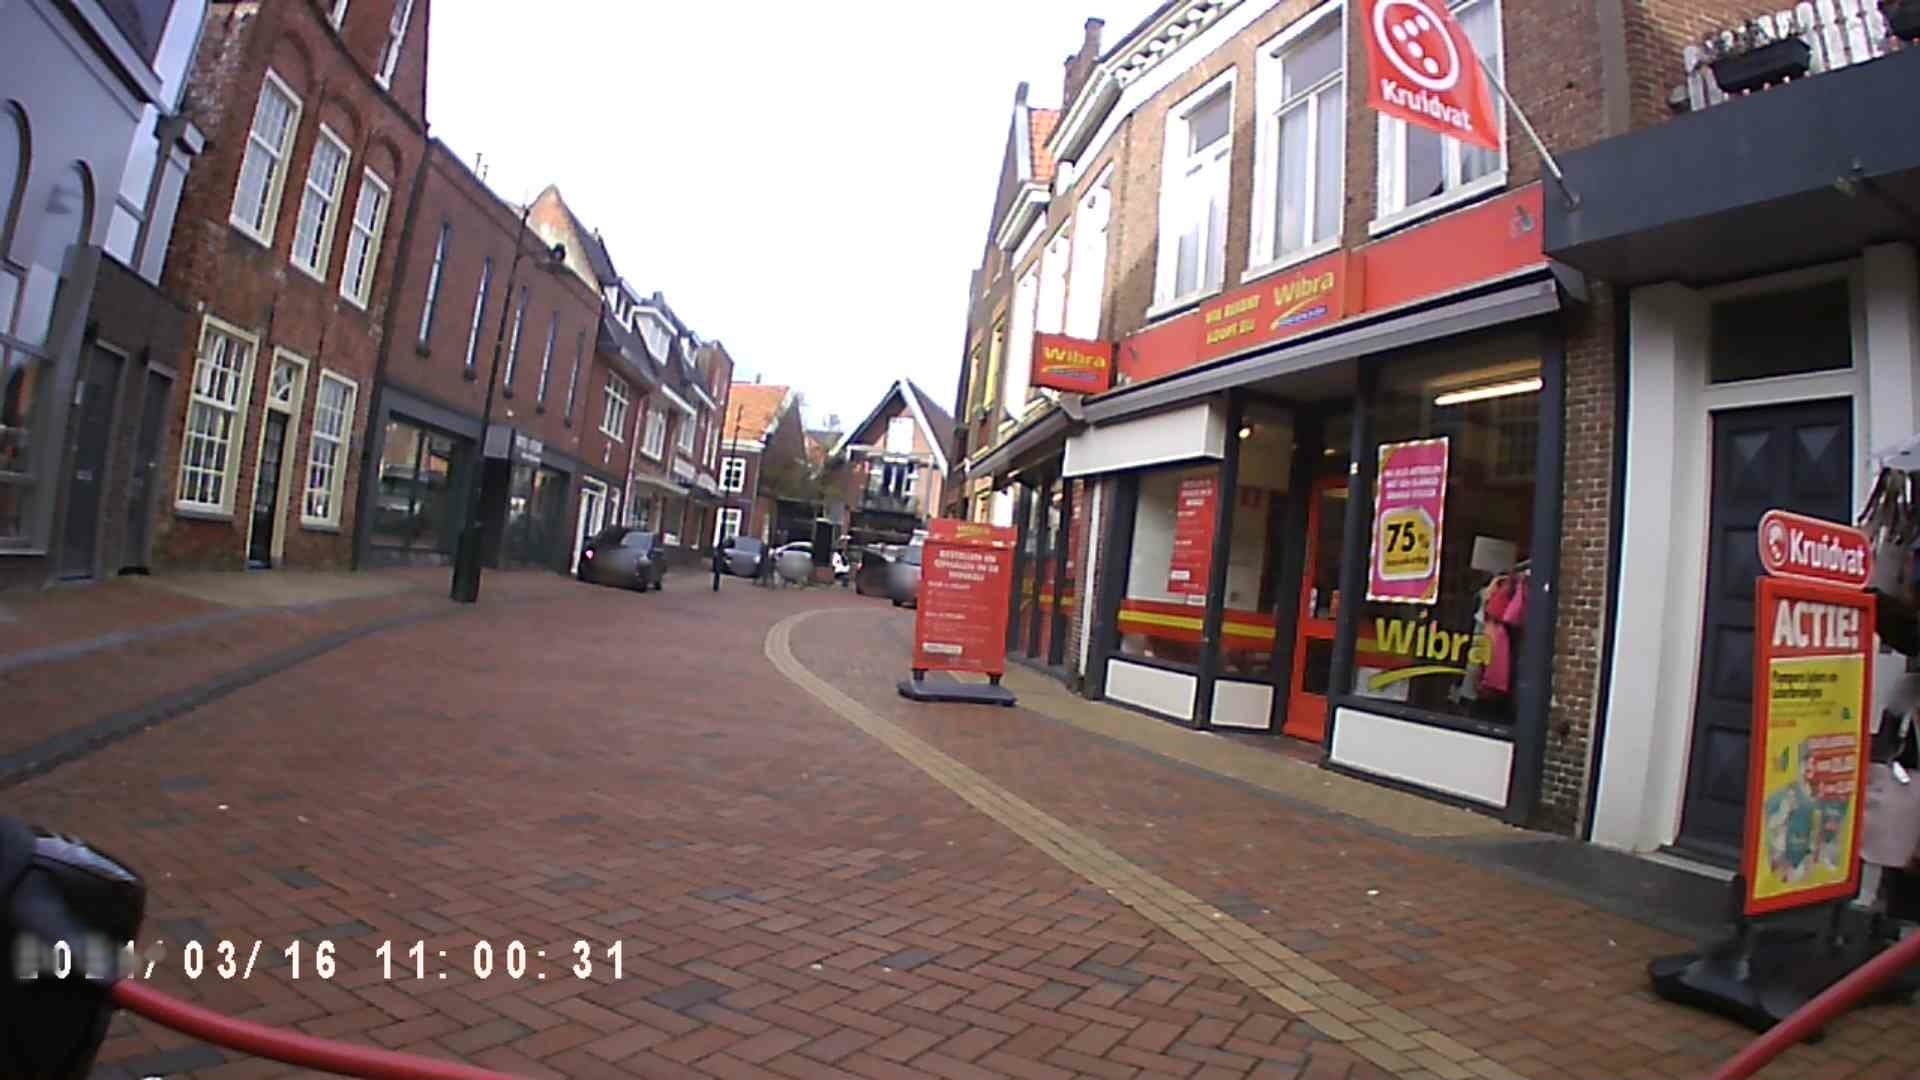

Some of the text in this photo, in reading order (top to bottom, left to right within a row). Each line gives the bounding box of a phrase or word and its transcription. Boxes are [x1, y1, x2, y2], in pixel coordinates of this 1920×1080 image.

[1380, 78, 1473, 131] Kruidvat
[1273, 271, 1335, 306] Wibra
[1043, 346, 1107, 368] Wibra
[1790, 528, 1865, 576] Kruidvat
[1376, 608, 1492, 666] Wibra
[1772, 599, 1859, 649] ACTIE!
